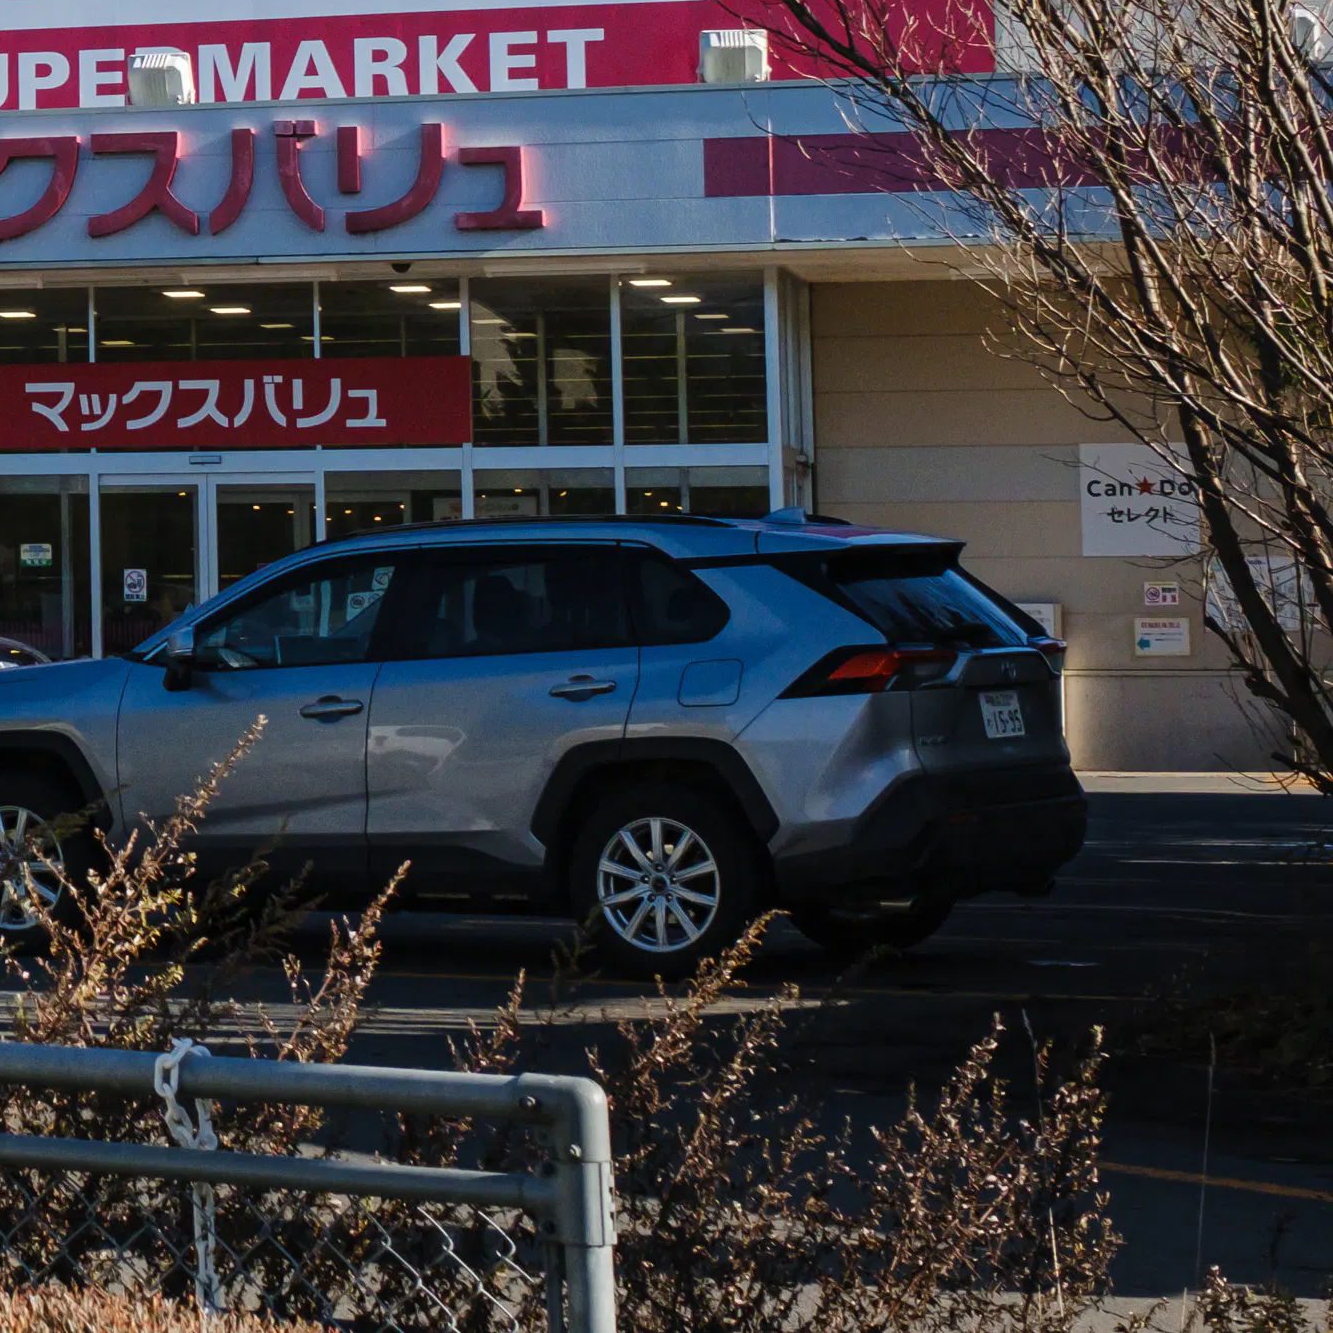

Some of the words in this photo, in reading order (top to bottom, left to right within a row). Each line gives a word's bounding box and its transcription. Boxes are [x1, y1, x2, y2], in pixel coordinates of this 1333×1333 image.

[24, 375, 388, 433] マックスバリュ
[1086, 479, 1132, 497] Can
[1159, 479, 1194, 496] Do
[1107, 506, 1174, 523] セレクト
